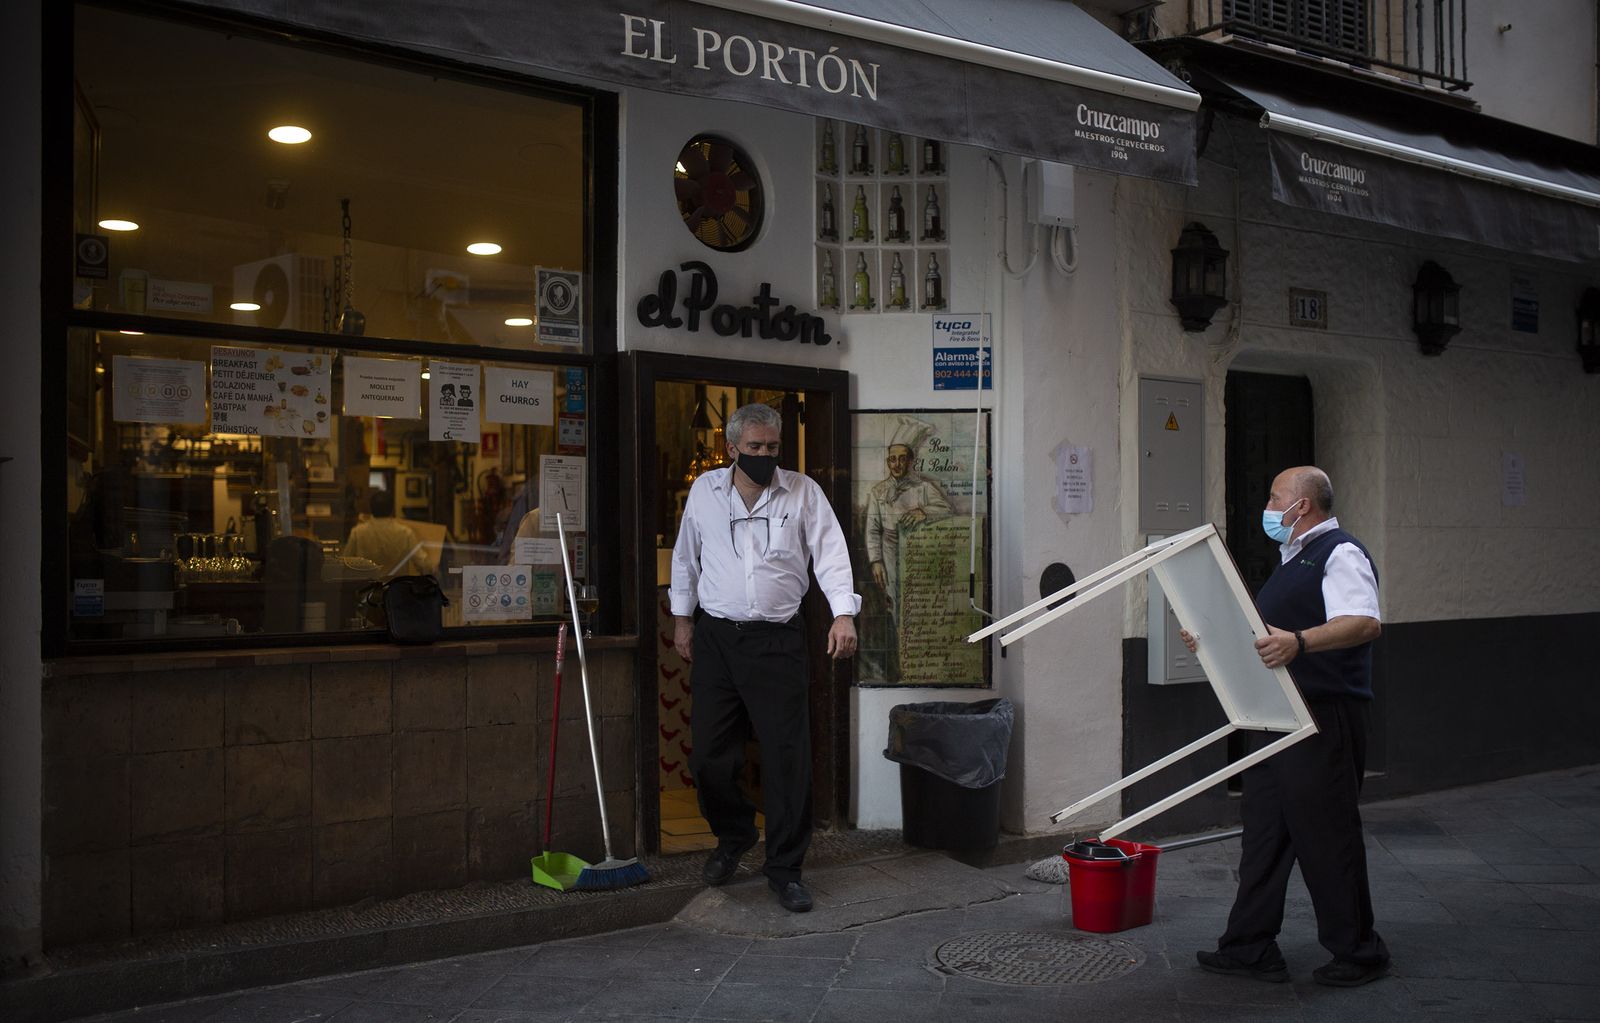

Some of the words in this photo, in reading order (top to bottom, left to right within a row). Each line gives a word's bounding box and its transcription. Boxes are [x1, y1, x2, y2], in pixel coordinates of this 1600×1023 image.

[619, 12, 677, 65] EL
[691, 26, 882, 102] PORTÓN
[1076, 103, 1161, 141] Cruzcampo
[1074, 129, 1115, 145] MAESTROS
[1116, 137, 1165, 153] CERVECEROS
[1111, 150, 1129, 161] 1904
[1300, 151, 1367, 186] Cruzcampo
[1298, 175, 1330, 188] MAESTROS
[1330, 182, 1370, 197] CERVECEROS
[637, 269, 683, 328] el
[1299, 298, 1318, 320] 18
[934, 320, 972, 333] tyco
[213, 347, 256, 358] DESAYUNOS
[935, 351, 975, 362] Alarma
[213, 359, 258, 369] BREAKFAST
[970, 361, 991, 369] pocía
[213, 370, 234, 379] PETIT
[236, 370, 275, 381] DÉJEUNER
[935, 369, 952, 378] 902
[953, 369, 972, 378] 444
[213, 381, 256, 391] COLAZIONE
[369, 383, 396, 391] MOLLETE
[511, 379, 530, 389] HAY
[213, 391, 232, 400] CAFÉ
[235, 392, 246, 401] DA
[247, 394, 274, 402] MANHÃ
[360, 393, 405, 402] ANTEQUERANO
[499, 394, 541, 407] CHURROS
[213, 402, 247, 412] ЗАВТРАК
[213, 424, 259, 434] FRÜHSTÜCK
[928, 438, 951, 454] Bar
[912, 458, 925, 473] El
